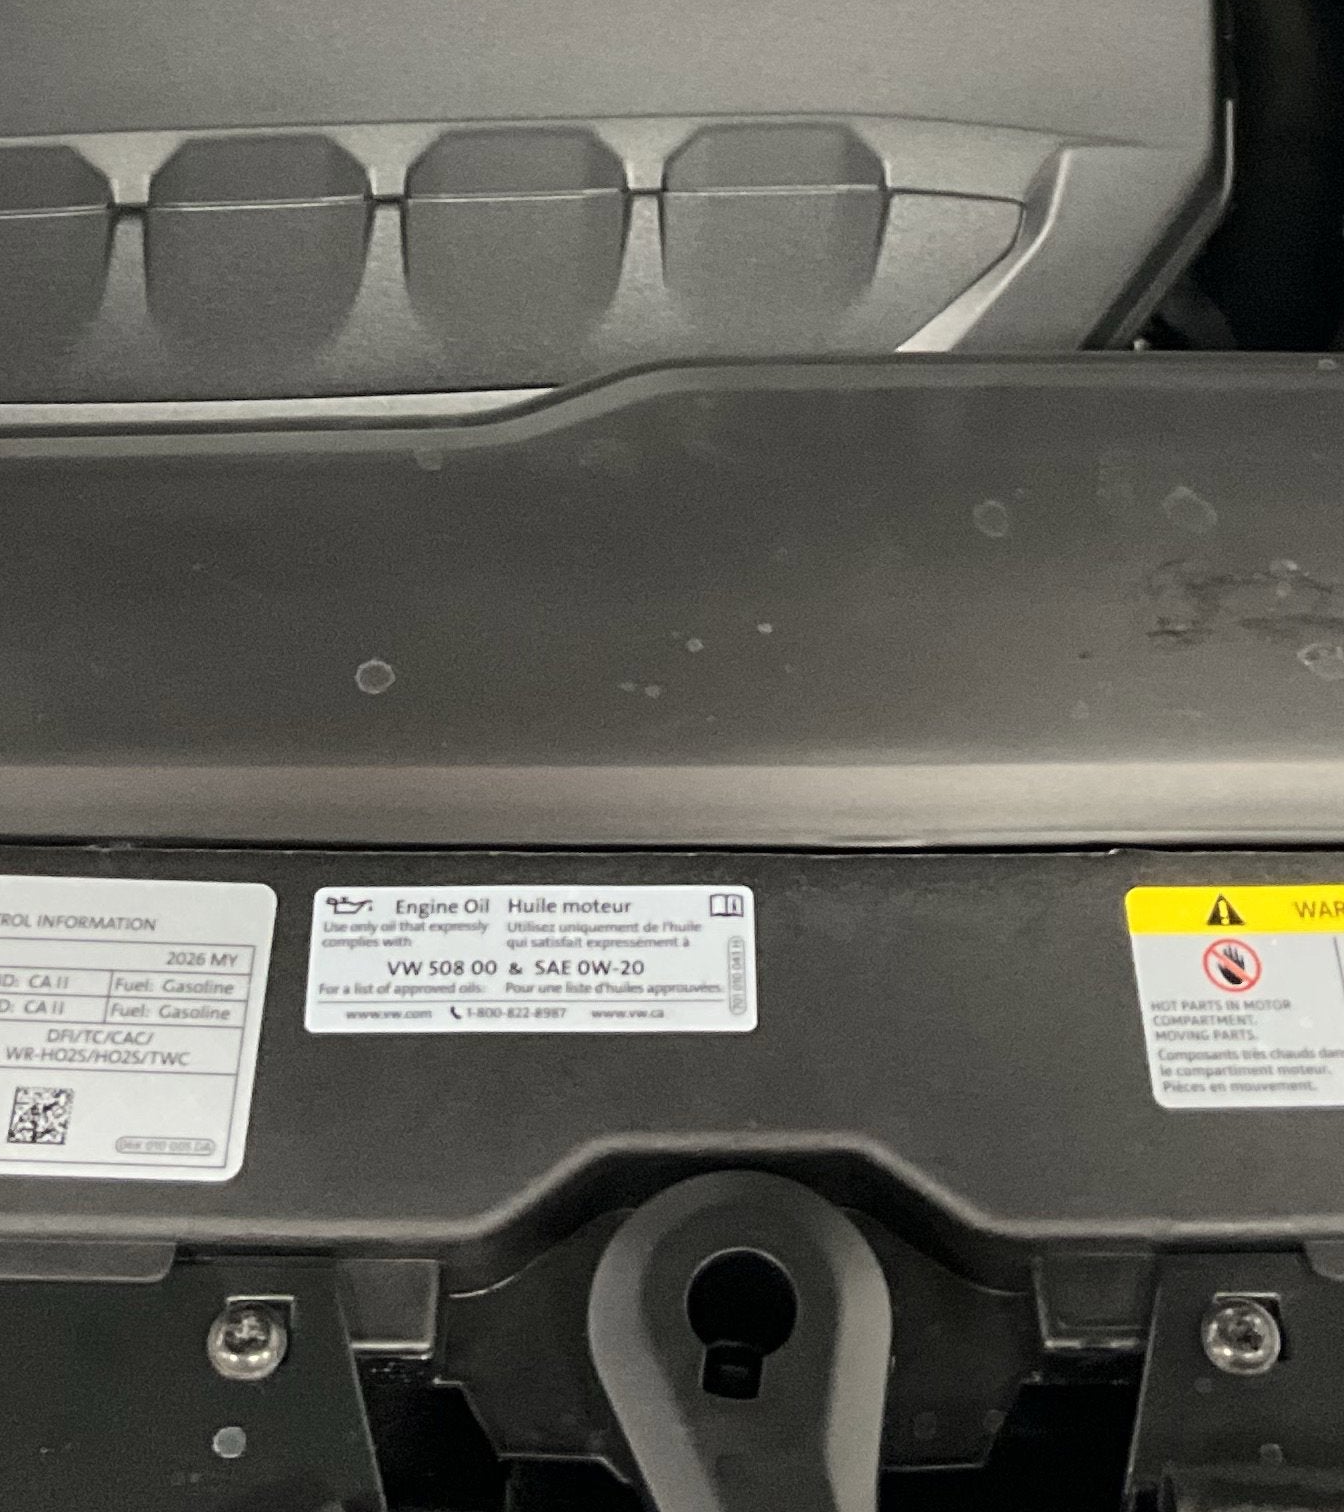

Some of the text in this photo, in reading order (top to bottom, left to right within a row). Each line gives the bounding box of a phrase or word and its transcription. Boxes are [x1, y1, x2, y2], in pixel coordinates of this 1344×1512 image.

[396, 899, 490, 919] Engine Oil
[508, 898, 632, 914] Huile moteur
[37, 912, 157, 931] INFORMATION
[323, 921, 489, 935] Use only oil that expressly
[507, 921, 555, 933] Utilisez
[558, 921, 640, 935] uniquement
[643, 921, 658, 933] de
[321, 937, 412, 950] complies with
[507, 937, 528, 951] qui
[531, 936, 582, 948] satisfait
[166, 951, 238, 968] 2026 MY
[387, 960, 646, 976] VW 508 00 & SAE 0W-20
[28, 974, 53, 989] CA
[114, 977, 234, 995] Fuel: Gasoline
[506, 983, 535, 994] Pour
[537, 984, 563, 994] une
[565, 982, 591, 994] liste
[318, 983, 340, 995] For
[342, 986, 351, 995] a
[355, 983, 374, 995] list
[376, 983, 391, 994] of
[393, 984, 456, 997] approved
[23, 1000, 48, 1015] CA
[110, 1003, 231, 1021] Fuel: Gasoline
[1151, 999, 1292, 1012] HOT PARTS IN MOTOR
[346, 1010, 433, 1020] www.vw.com
[466, 1007, 567, 1019] 1-800-822-8987
[591, 1007, 665, 1019] www.vw.ca
[1155, 1030, 1210, 1041] MOVING
[6, 1046, 192, 1067] WR-HO2S/HO2S/TWC
[1158, 1049, 1239, 1063] Composants
[1160, 1065, 1172, 1077] le
[1176, 1064, 1274, 1079] compartiment
[1209, 1082, 1227, 1092] en
